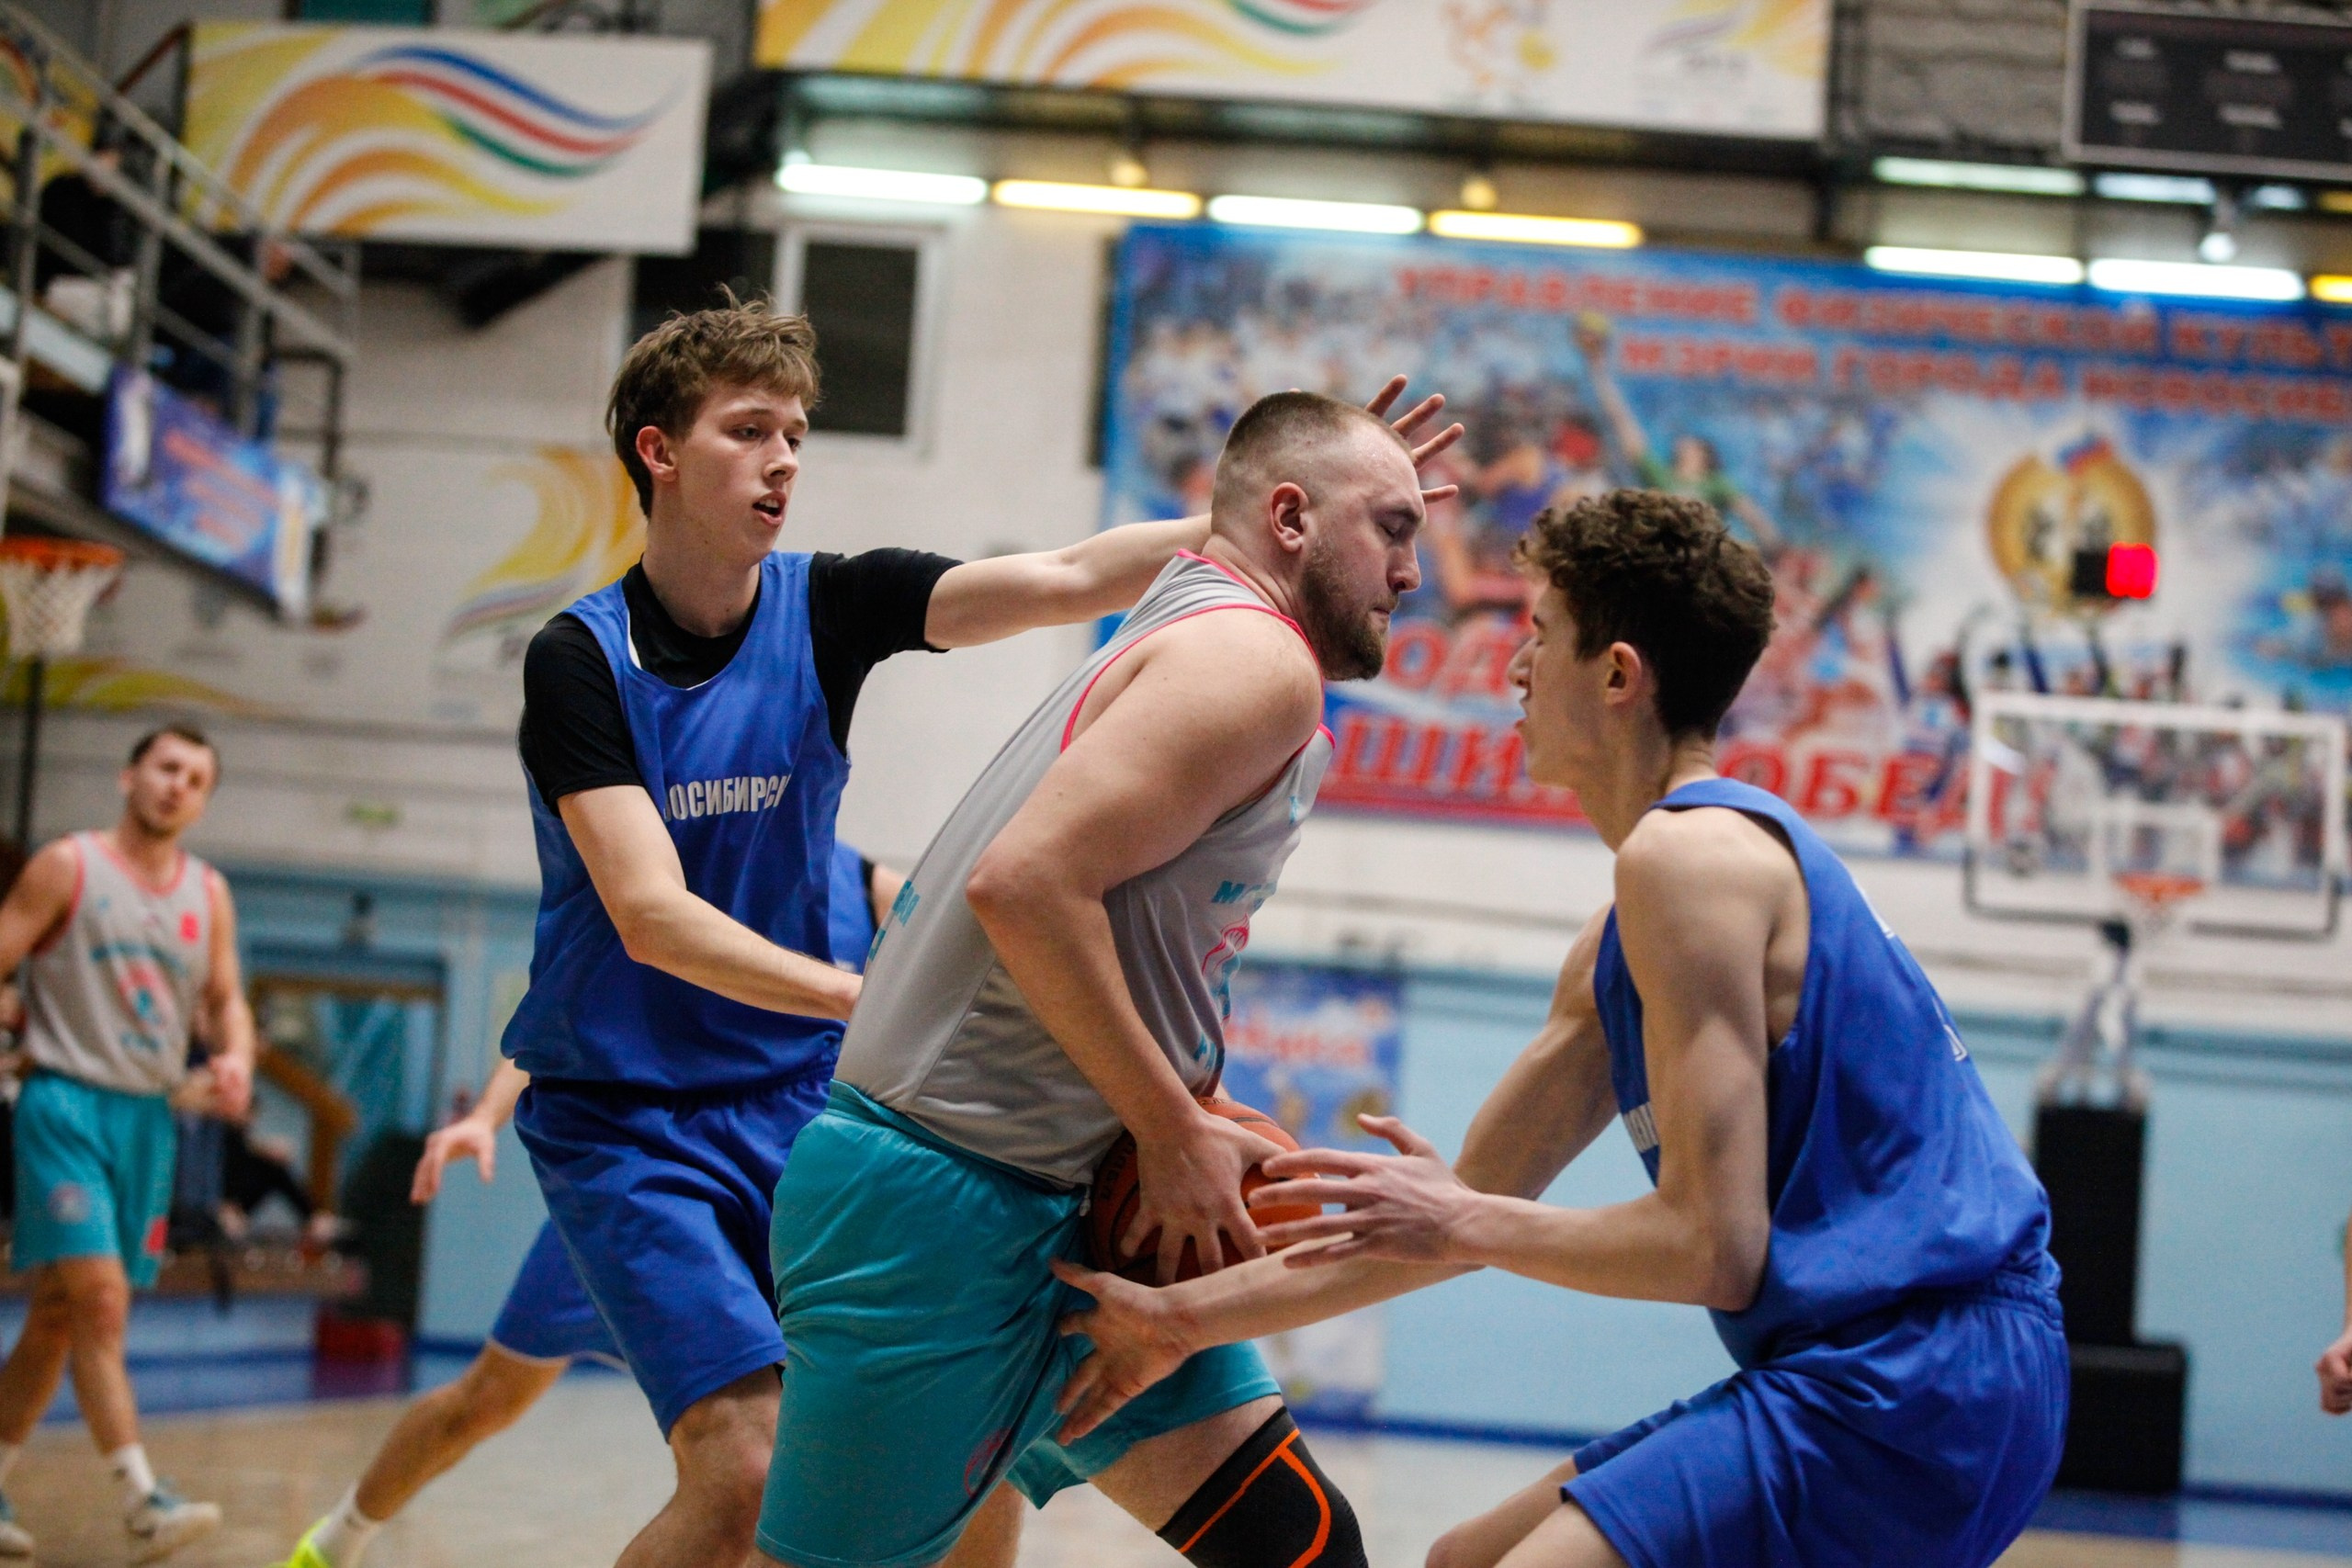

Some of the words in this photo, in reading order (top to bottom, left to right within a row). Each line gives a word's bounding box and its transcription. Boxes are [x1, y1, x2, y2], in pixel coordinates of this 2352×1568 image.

[2083, 369, 2352, 423] НОВОСИБ
[1384, 623, 1514, 696] ОД
[1339, 716, 1523, 791] ШИ
